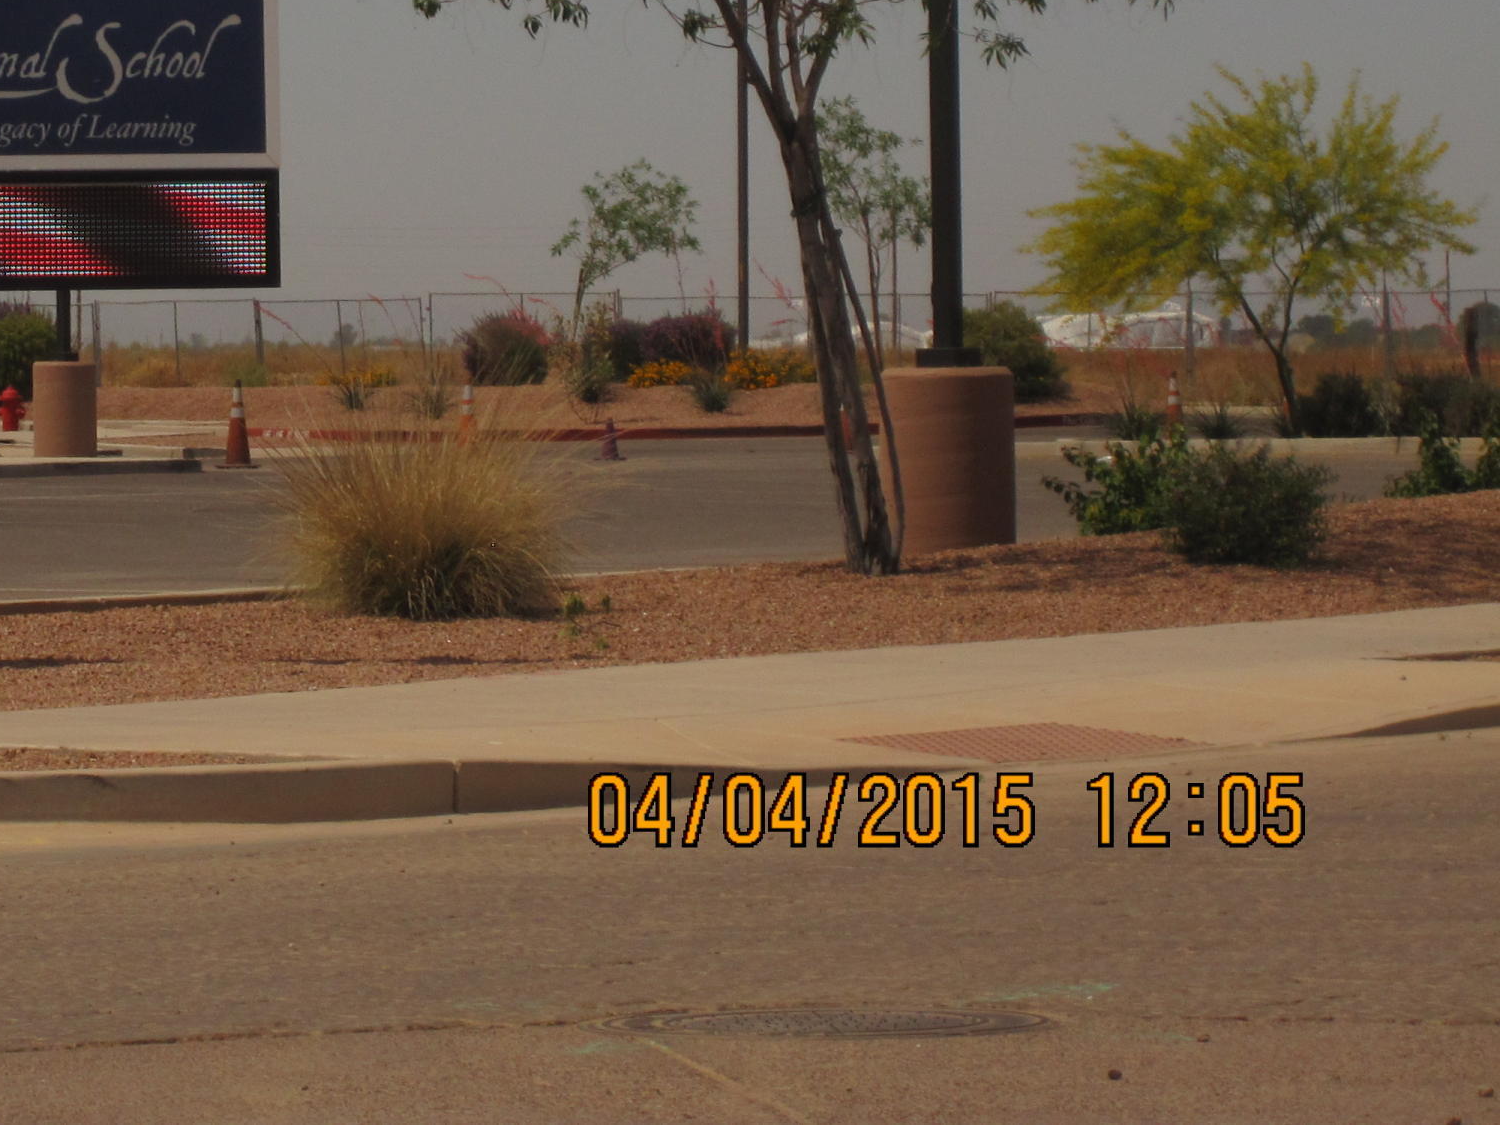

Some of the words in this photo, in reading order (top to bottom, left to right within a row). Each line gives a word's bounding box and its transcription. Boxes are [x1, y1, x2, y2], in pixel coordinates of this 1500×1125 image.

[56, 14, 242, 104] School
[57, 113, 88, 147] of
[86, 113, 197, 147] Learning
